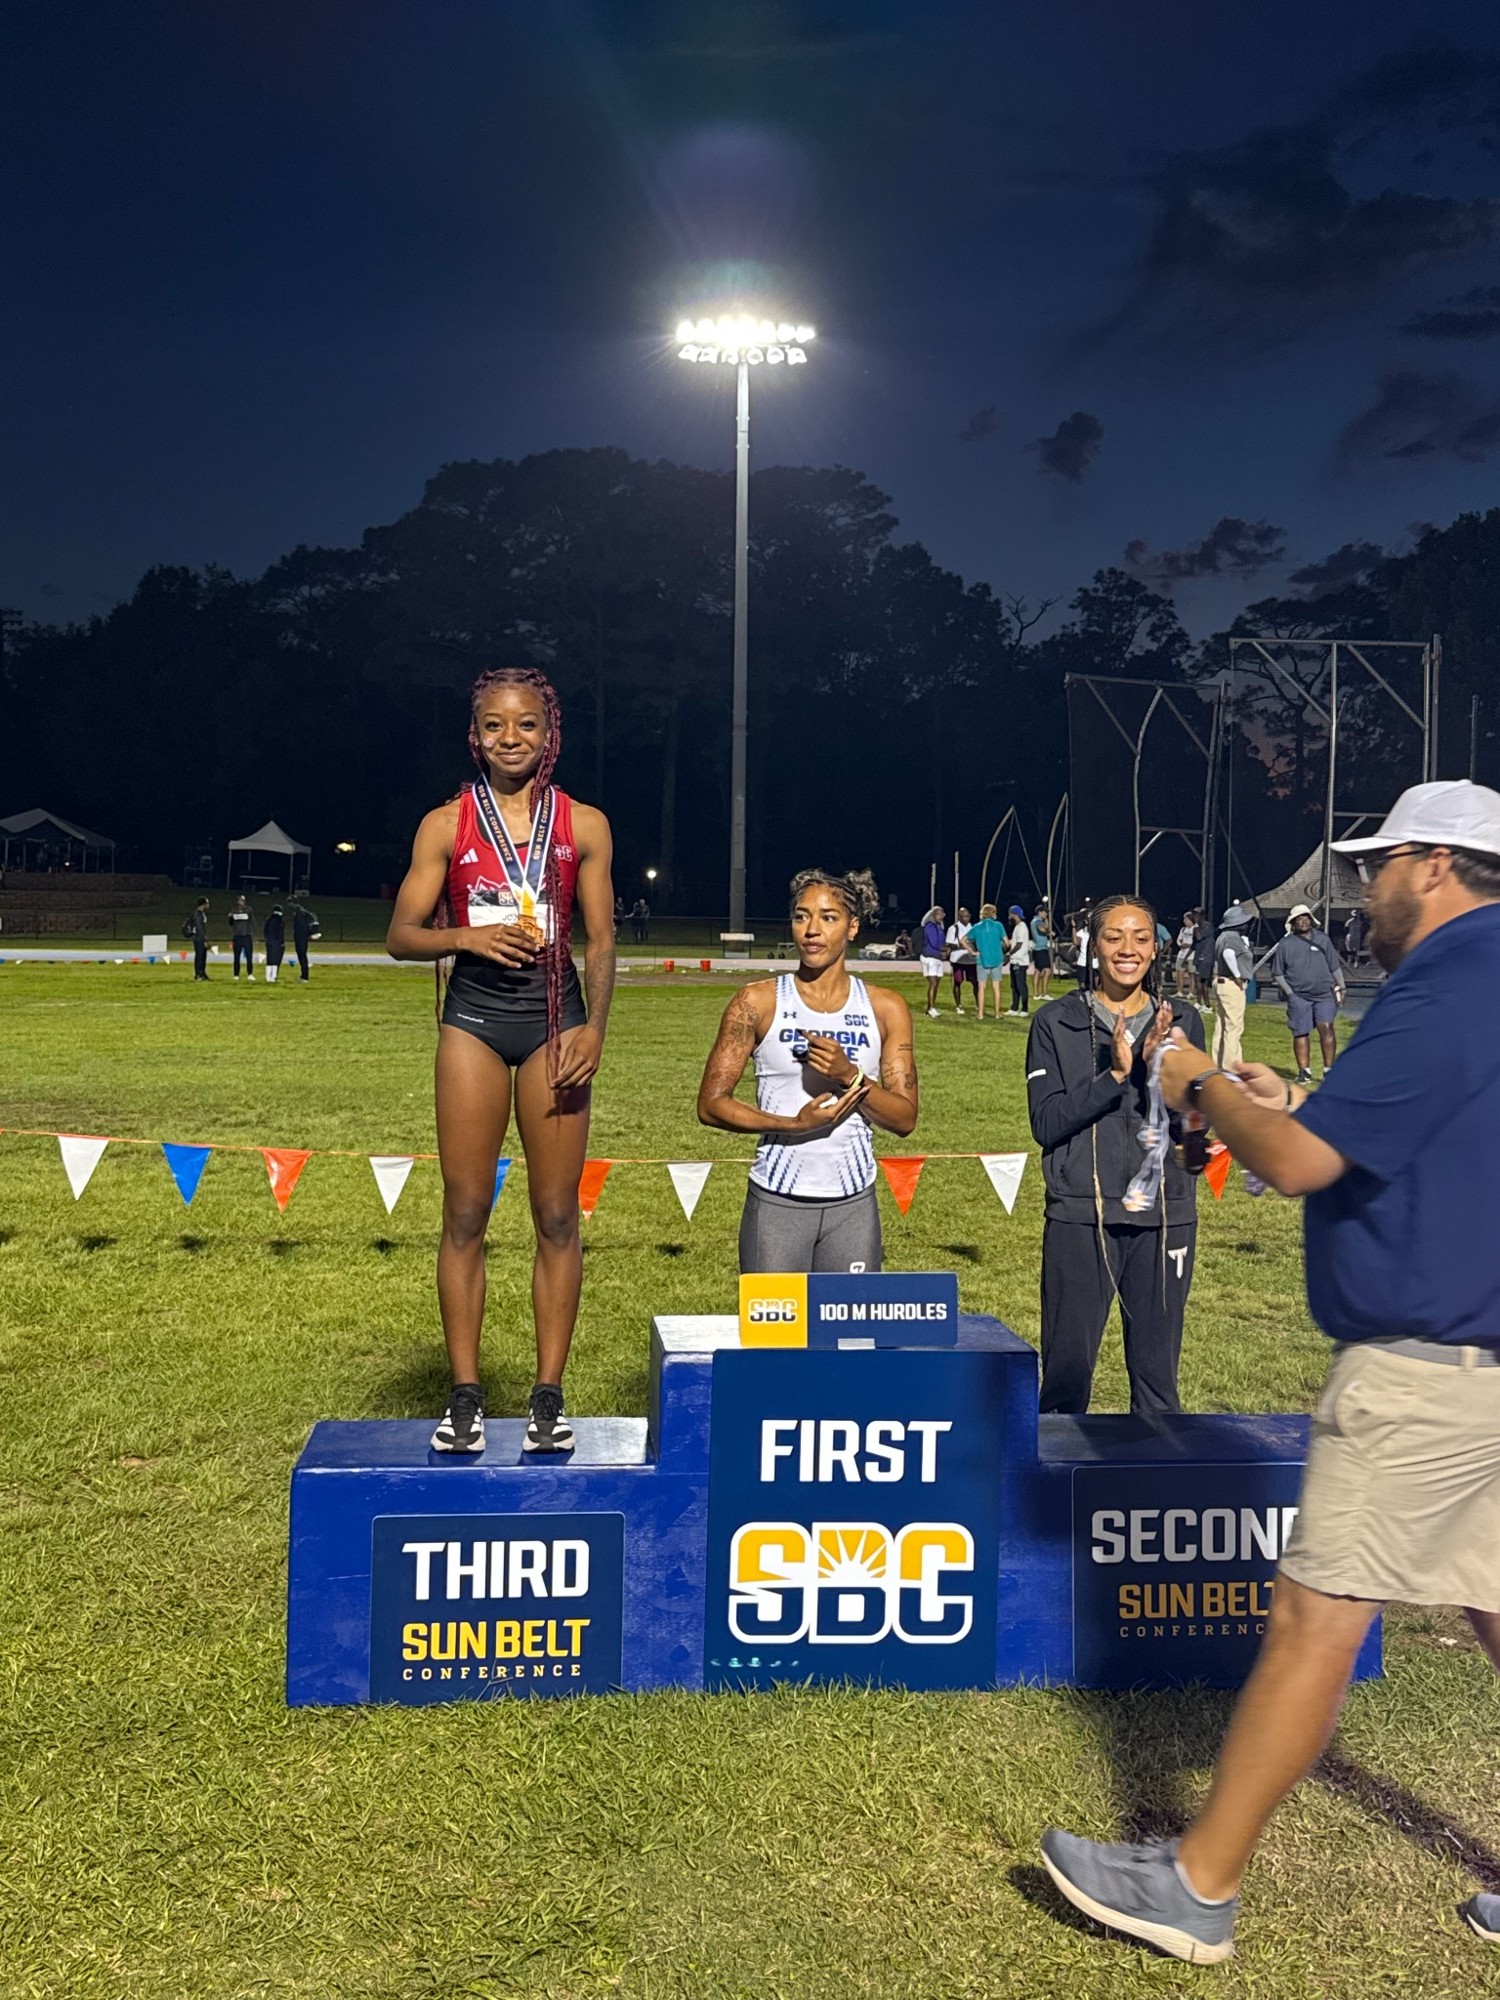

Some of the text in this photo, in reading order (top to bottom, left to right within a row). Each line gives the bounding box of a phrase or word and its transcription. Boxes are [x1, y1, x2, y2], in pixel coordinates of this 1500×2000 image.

[482, 799, 494, 815] BELT
[489, 816, 513, 862] CONFERENCE
[533, 786, 551, 860] SUN BELT CONFERENC
[844, 1014, 870, 1028] SBC
[748, 1298, 797, 1323] SBC
[819, 1303, 947, 1321] 100 M HURDLES
[760, 1419, 953, 1483] FIRST
[402, 1539, 590, 1600] THIRD
[728, 1521, 974, 1644] SBC
[1119, 1583, 1195, 1619] SUN
[402, 1618, 591, 1661] SUN BELT
[1119, 1623, 1265, 1638] CONFERENC
[402, 1664, 581, 1681] CONFERENCE
